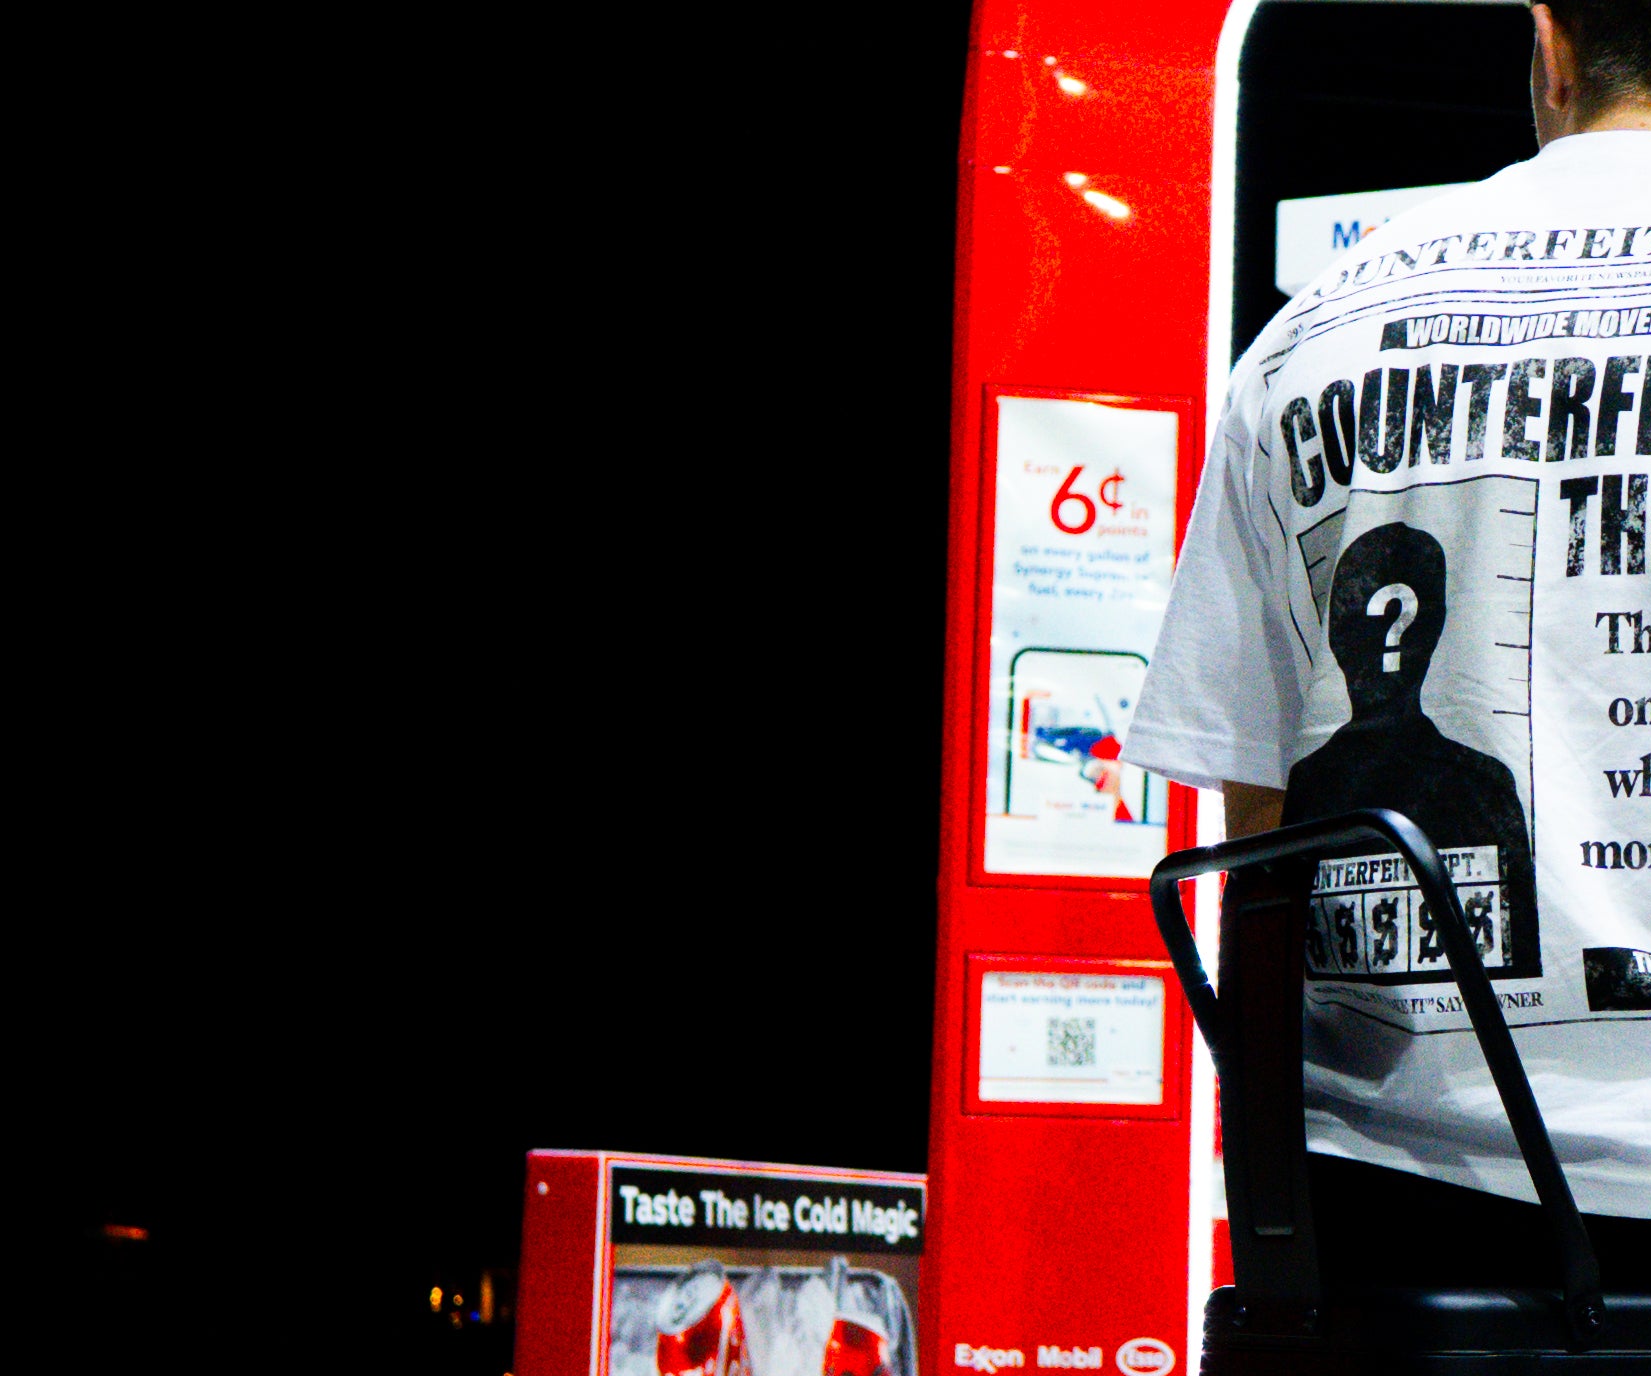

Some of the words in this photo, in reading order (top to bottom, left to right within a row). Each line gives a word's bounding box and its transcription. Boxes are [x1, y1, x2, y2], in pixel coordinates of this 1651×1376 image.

[1406, 311, 1570, 348] WORLDWIDE
[620, 1185, 696, 1227] Taste
[700, 1189, 749, 1229] The
[754, 1194, 790, 1232] Ice
[794, 1196, 848, 1235] Cold
[852, 1198, 919, 1245] Magic
[954, 1342, 1026, 1376] Exxon
[1037, 1344, 1103, 1369] Mobil
